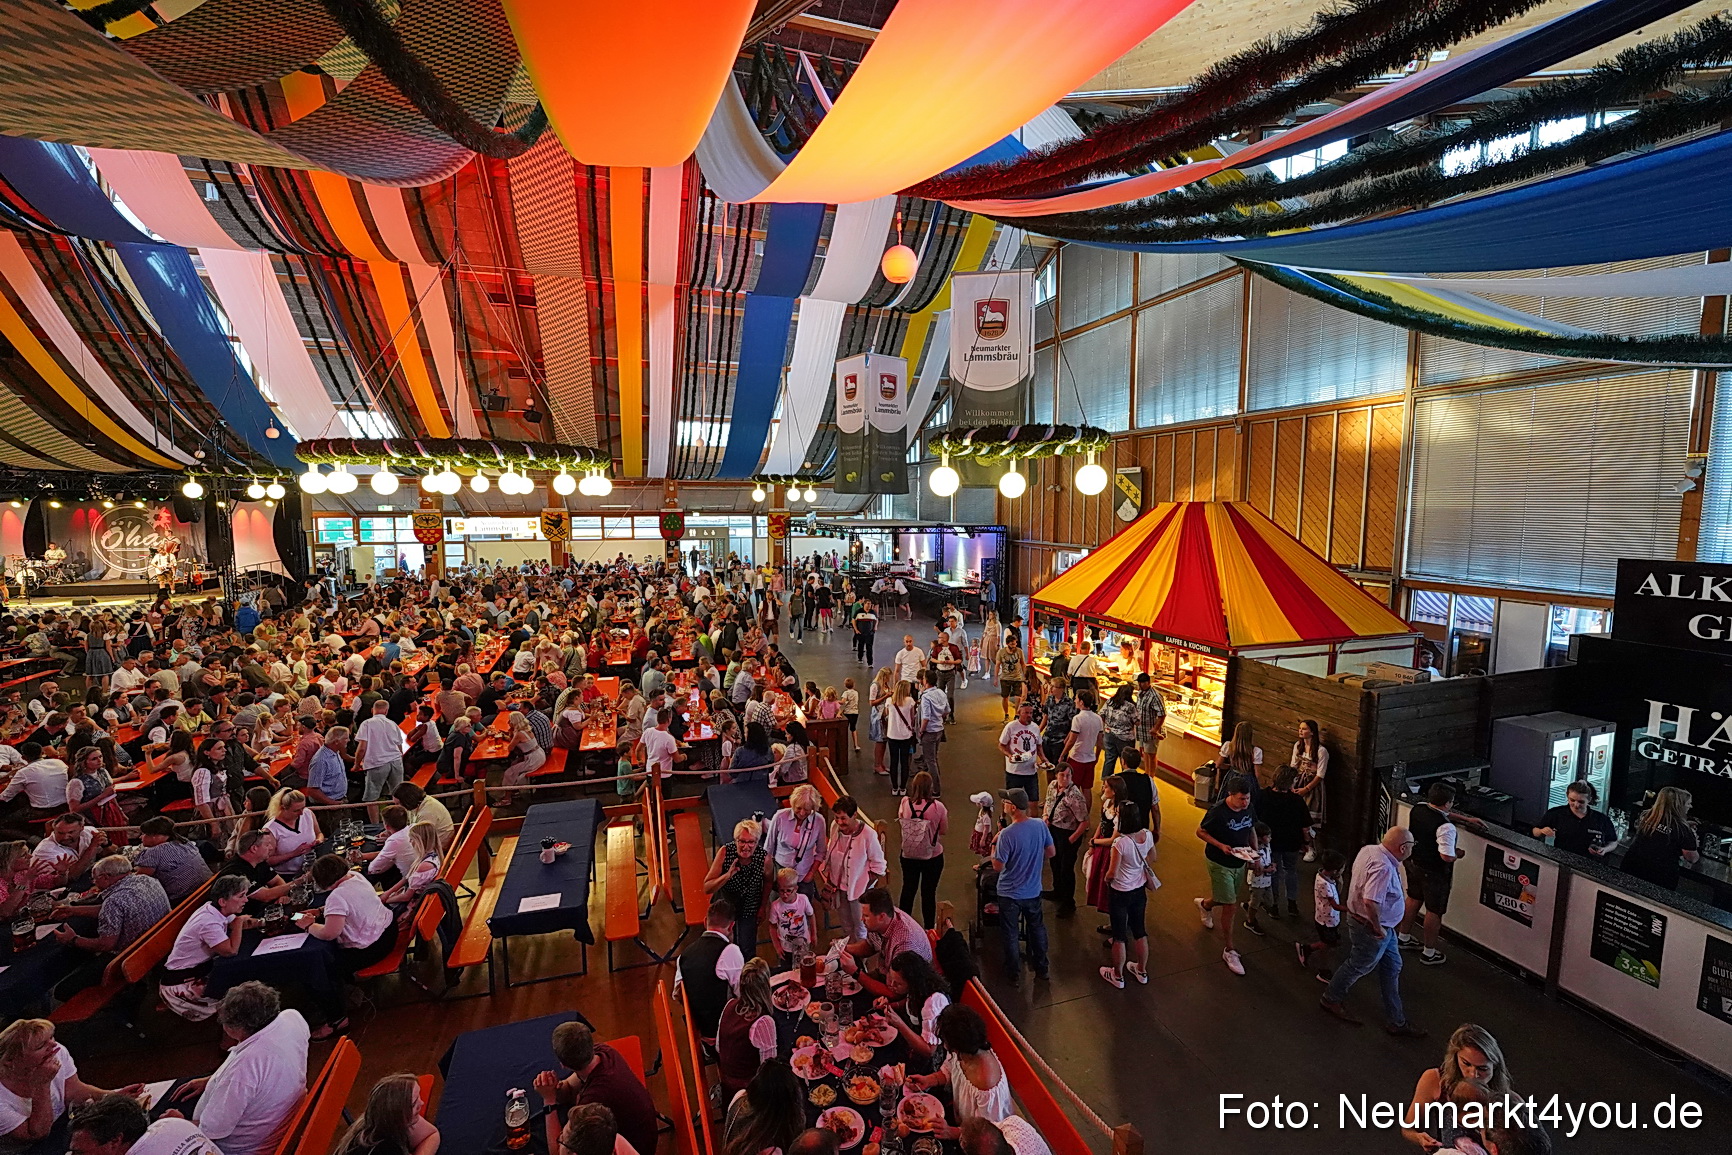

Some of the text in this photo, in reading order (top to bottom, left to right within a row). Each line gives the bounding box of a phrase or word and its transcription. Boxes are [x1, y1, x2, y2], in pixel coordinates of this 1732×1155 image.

[970, 344, 1012, 352] Neumarkter
[964, 352, 1018, 362] Lammsbräu
[1166, 636, 1182, 646] KAFFEE
[1496, 894, 1518, 908] 7,80
[1519, 904, 1527, 912] €
